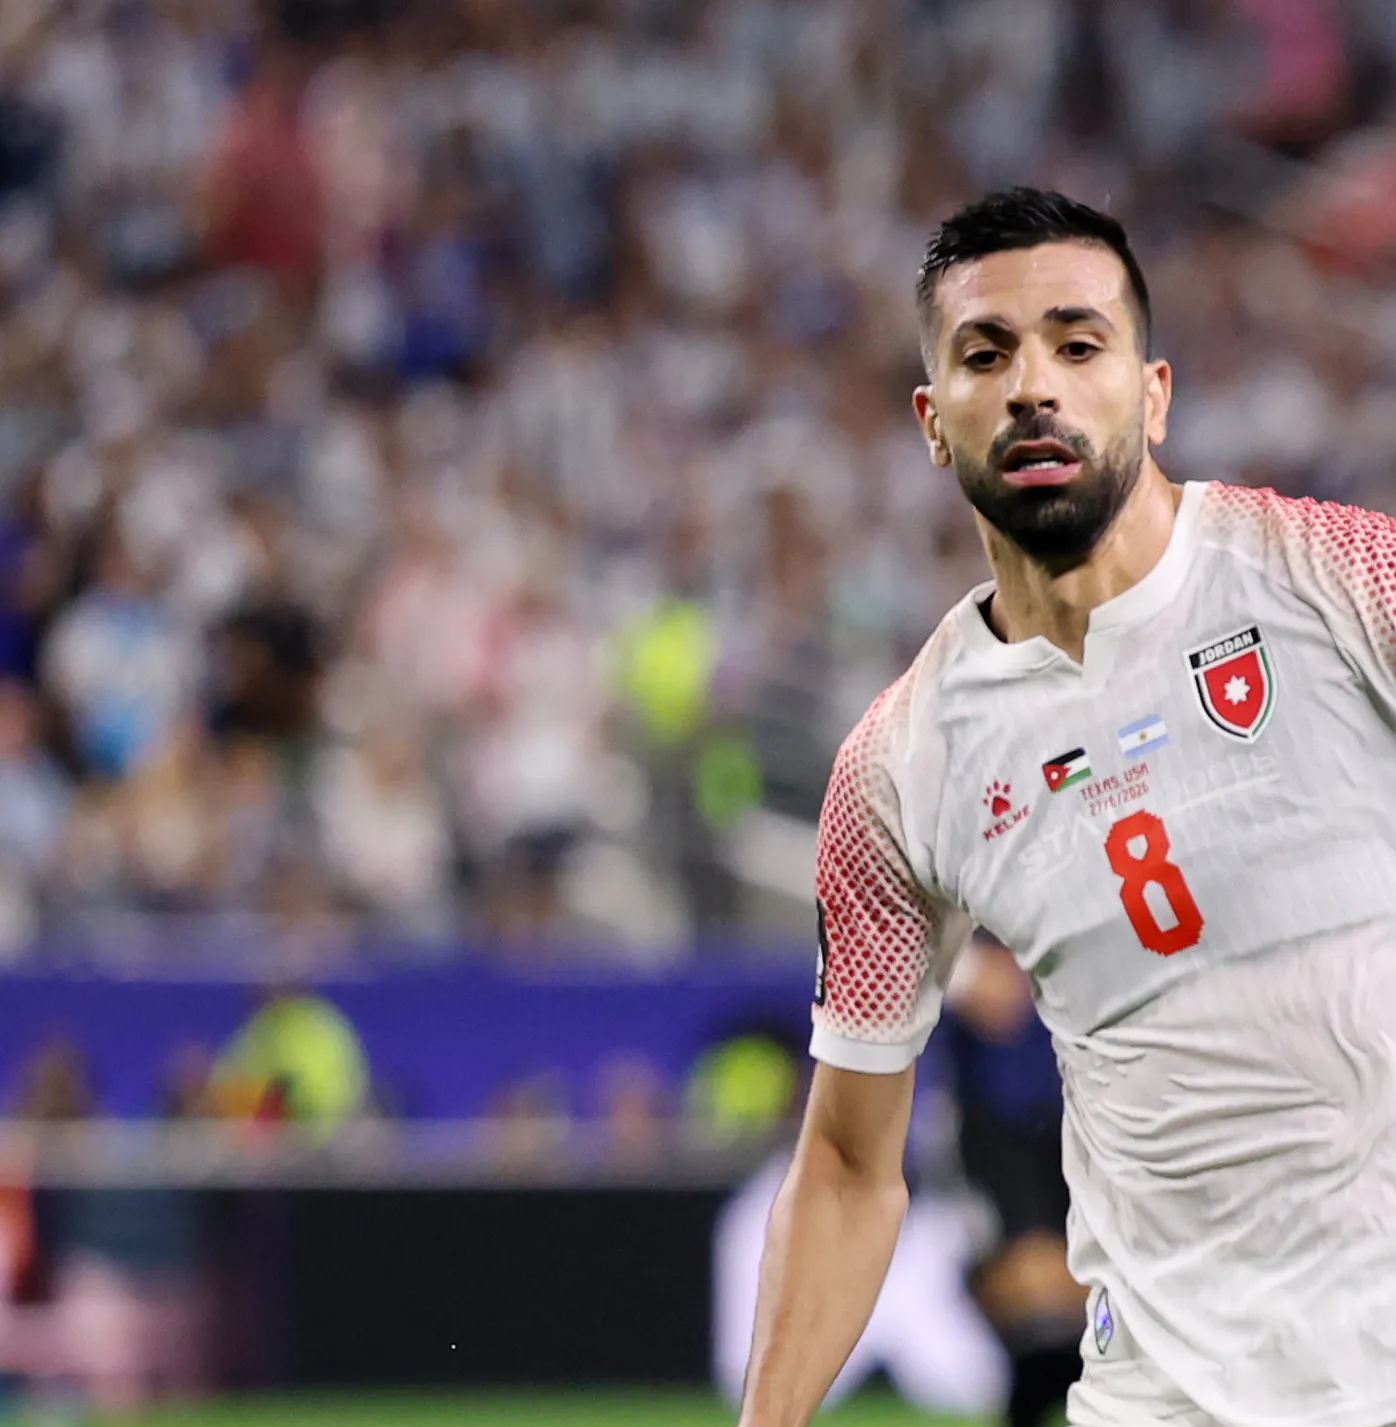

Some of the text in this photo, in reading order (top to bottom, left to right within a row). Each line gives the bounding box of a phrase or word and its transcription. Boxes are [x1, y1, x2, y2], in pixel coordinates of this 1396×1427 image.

[1199, 631, 1254, 666] JORDAN
[1124, 762, 1149, 783] USA
[1104, 808, 1205, 957] 8
